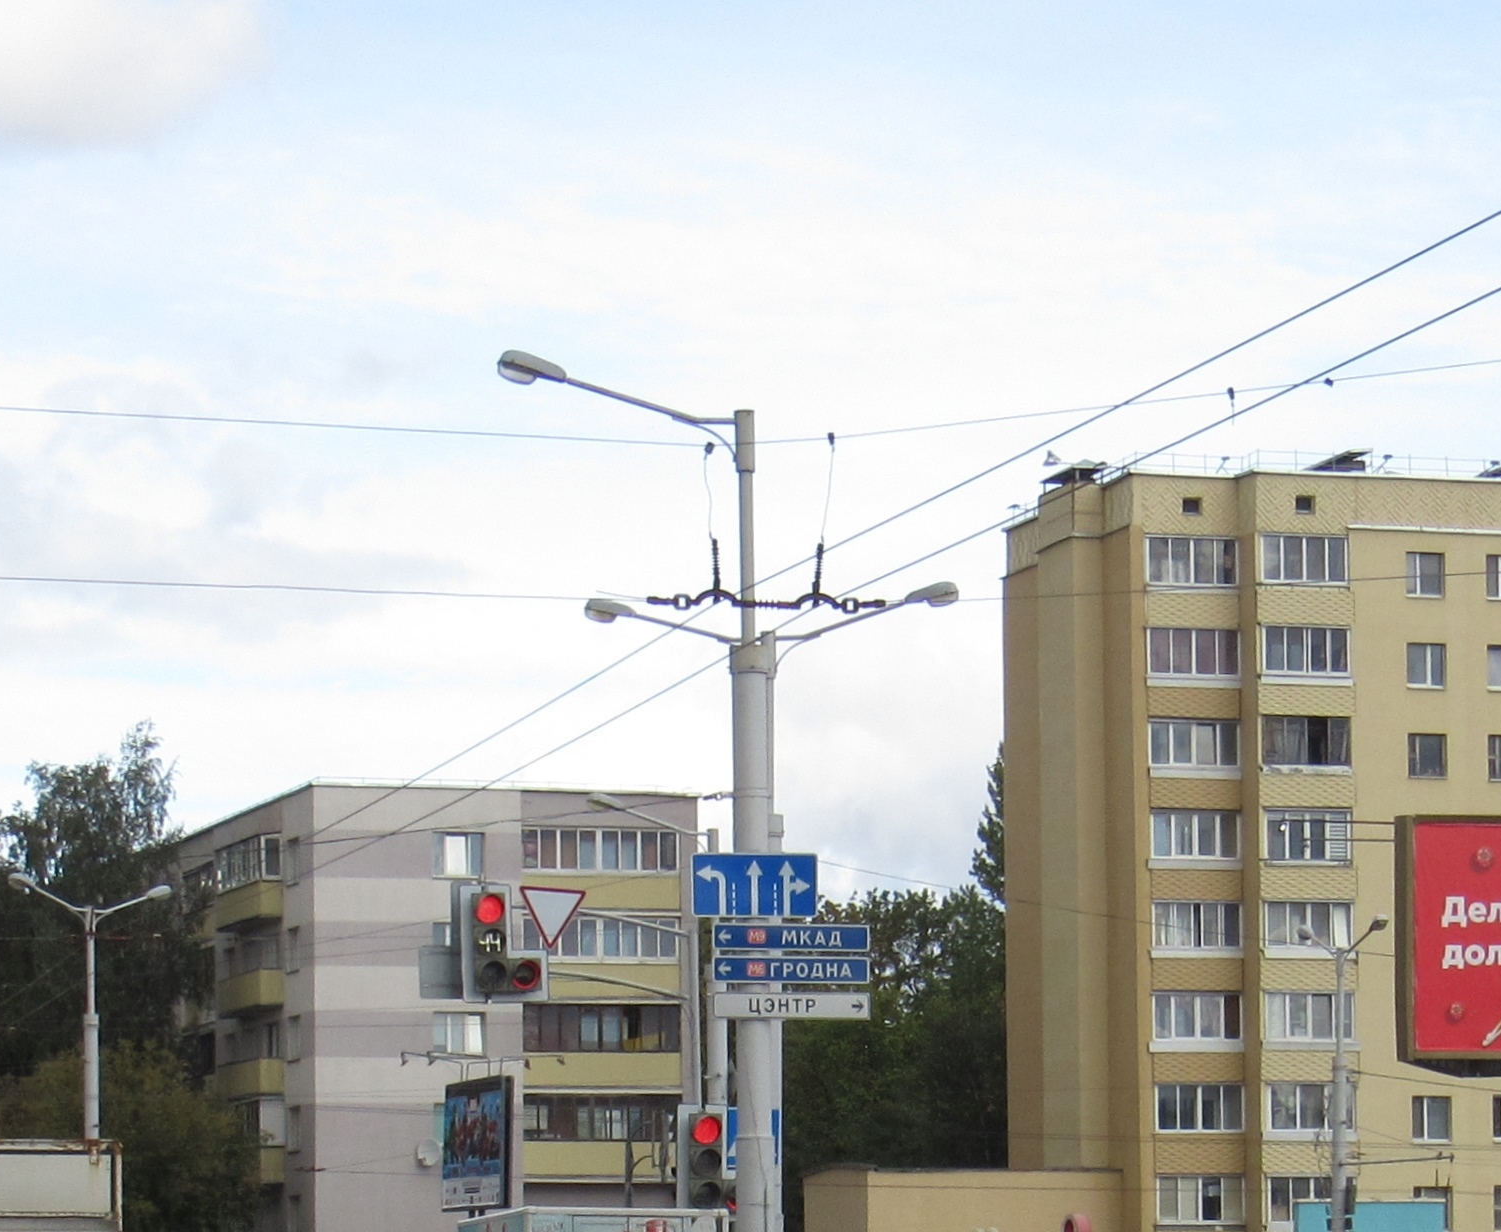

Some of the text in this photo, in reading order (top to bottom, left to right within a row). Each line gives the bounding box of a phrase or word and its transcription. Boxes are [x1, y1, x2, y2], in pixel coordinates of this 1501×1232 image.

[781, 930, 842, 947] МКАД
[770, 962, 852, 979] ГРОДНА
[749, 997, 817, 1015] ЦЭНТР
